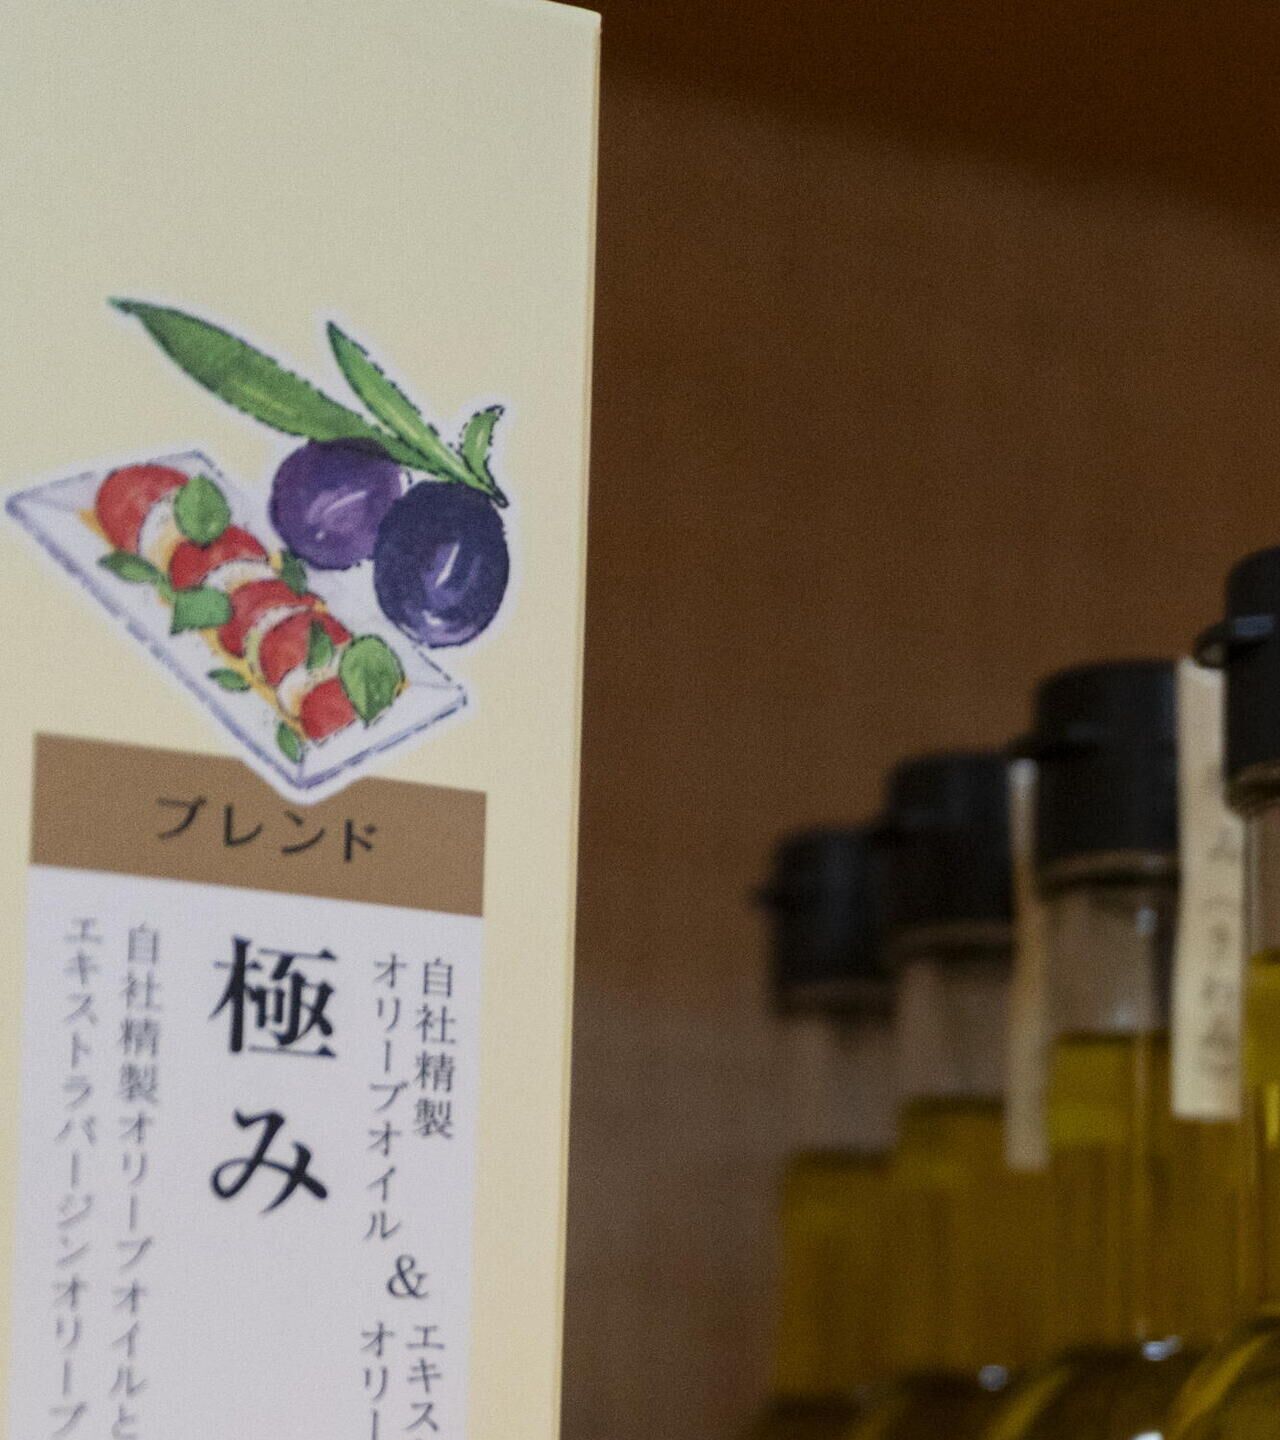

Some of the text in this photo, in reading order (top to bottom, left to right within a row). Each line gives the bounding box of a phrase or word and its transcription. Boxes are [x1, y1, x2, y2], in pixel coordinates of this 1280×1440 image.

[157, 795, 377, 863] ブレンド
[208, 935, 338, 1215] 極み
[363, 952, 409, 1242] オリーブオイル
[413, 956, 456, 1141] 自社精製
[385, 1253, 429, 1300] &
